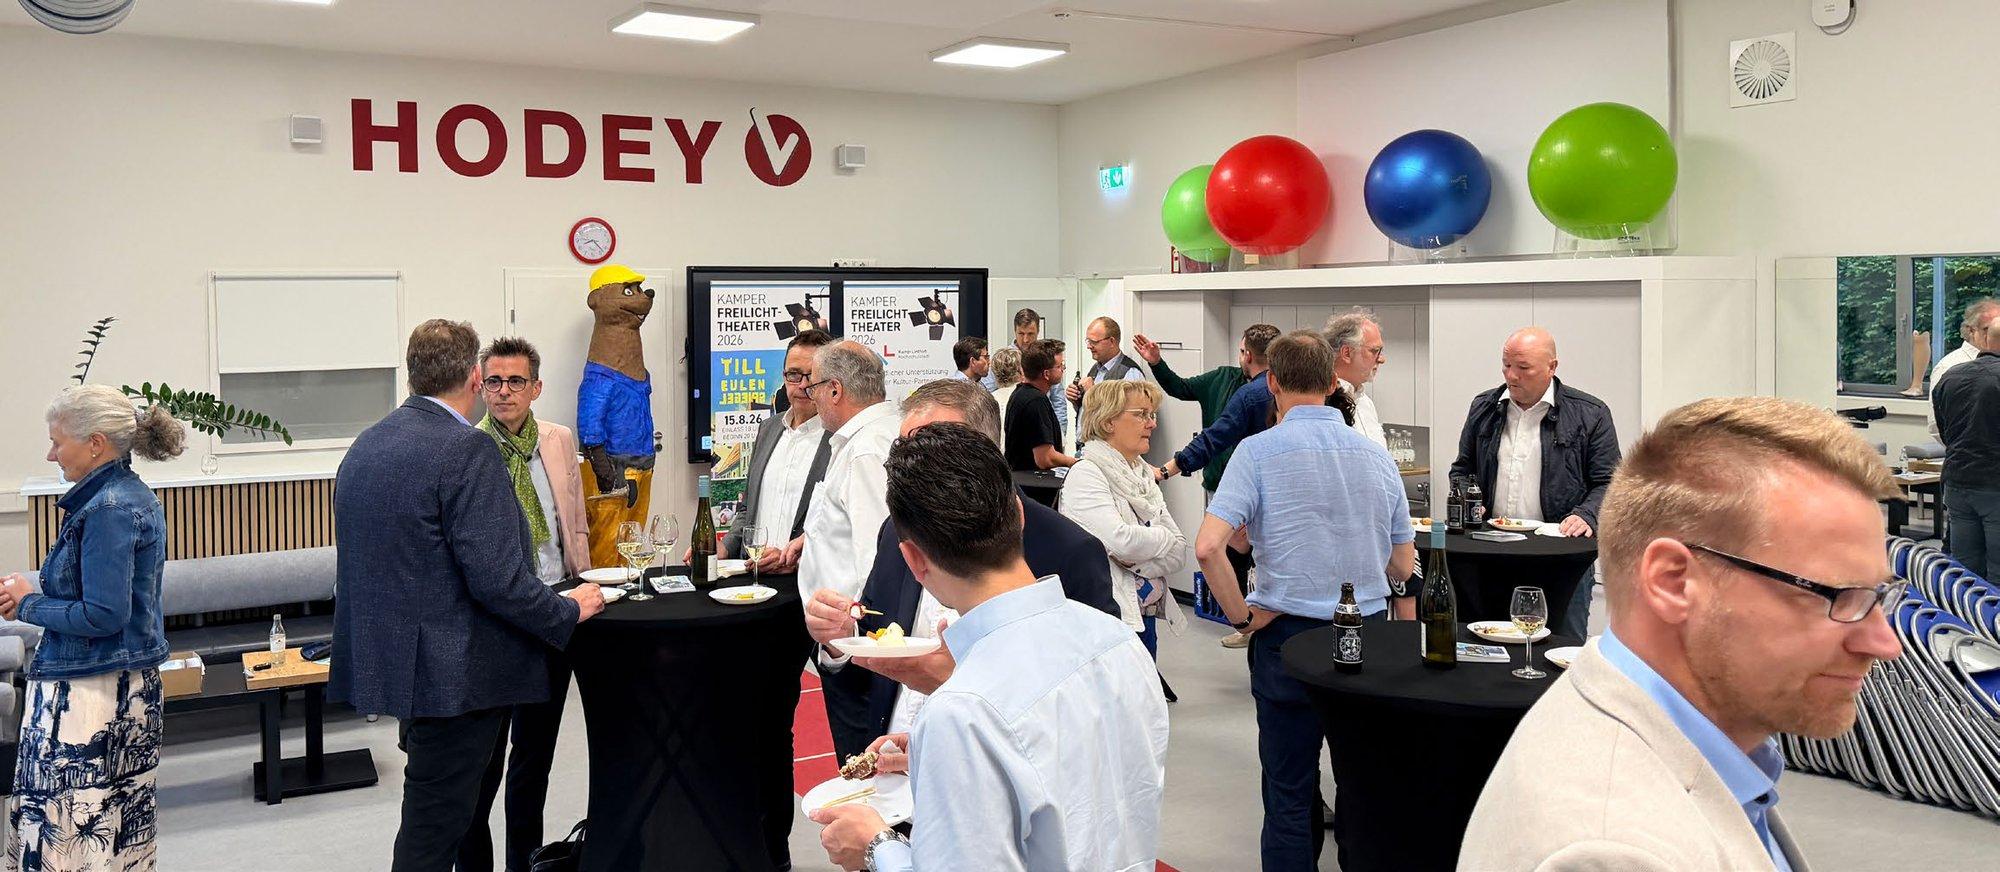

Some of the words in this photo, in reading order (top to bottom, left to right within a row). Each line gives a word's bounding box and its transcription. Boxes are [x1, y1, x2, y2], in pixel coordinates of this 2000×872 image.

[351, 98, 723, 185] HODEY
[716, 293, 767, 305] KAMPER
[850, 296, 897, 307] KAMPER
[717, 306, 782, 318] FREILICHT-
[717, 320, 770, 332] THEATER
[851, 321, 901, 332] THEATER
[717, 334, 744, 346] 2026
[851, 334, 876, 345] 2026
[720, 357, 767, 376] TILL
[720, 378, 766, 391] EULEN
[724, 413, 763, 425] 15.8.26
